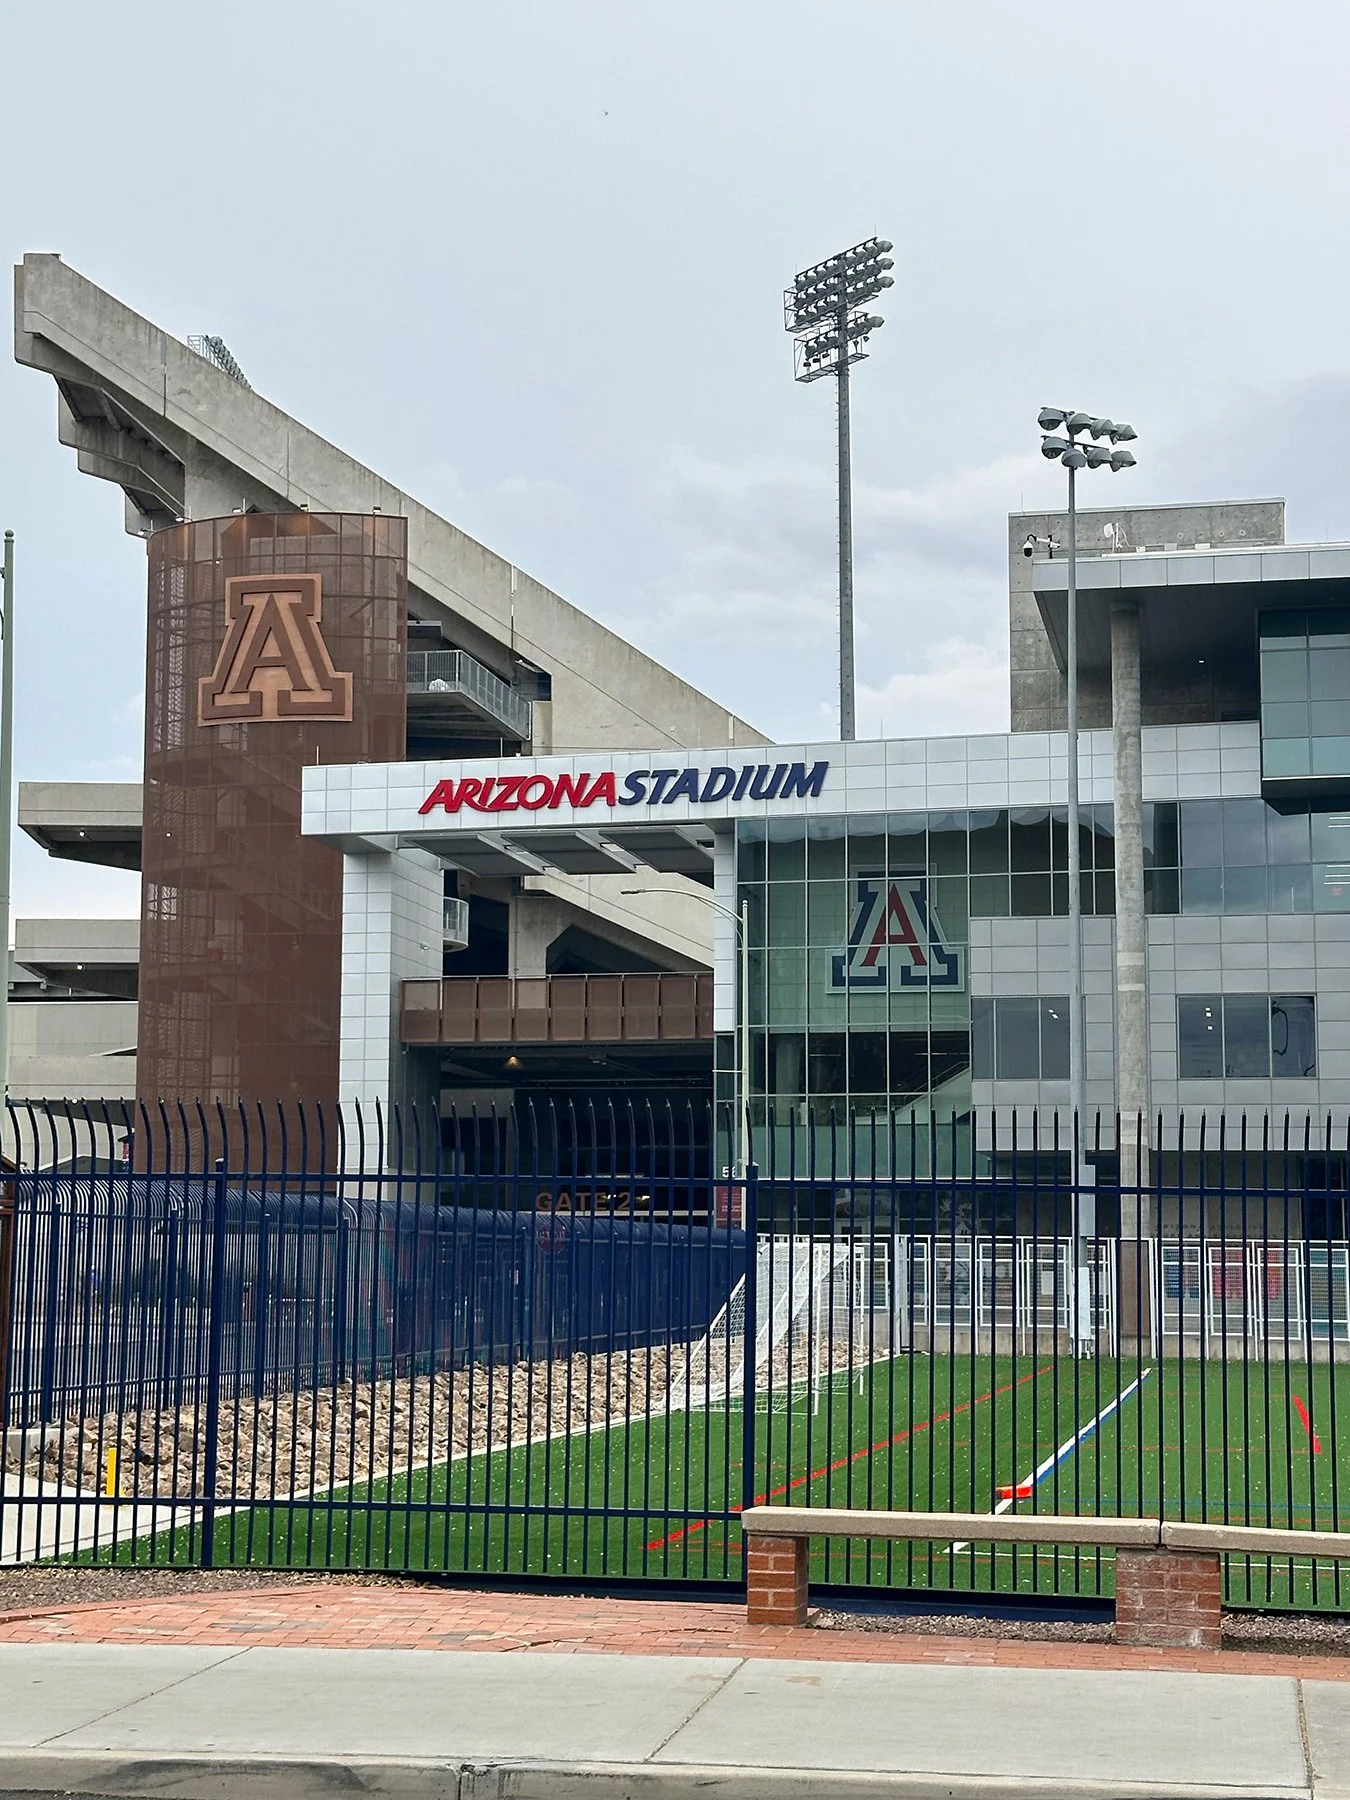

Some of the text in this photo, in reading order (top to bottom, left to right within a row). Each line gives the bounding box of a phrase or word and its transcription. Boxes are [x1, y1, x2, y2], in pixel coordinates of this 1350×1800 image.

[198, 574, 353, 727] A
[418, 761, 830, 814] ARIZONA STADIUM
[829, 868, 961, 989] A
[536, 1191, 631, 1211] GATE 2
